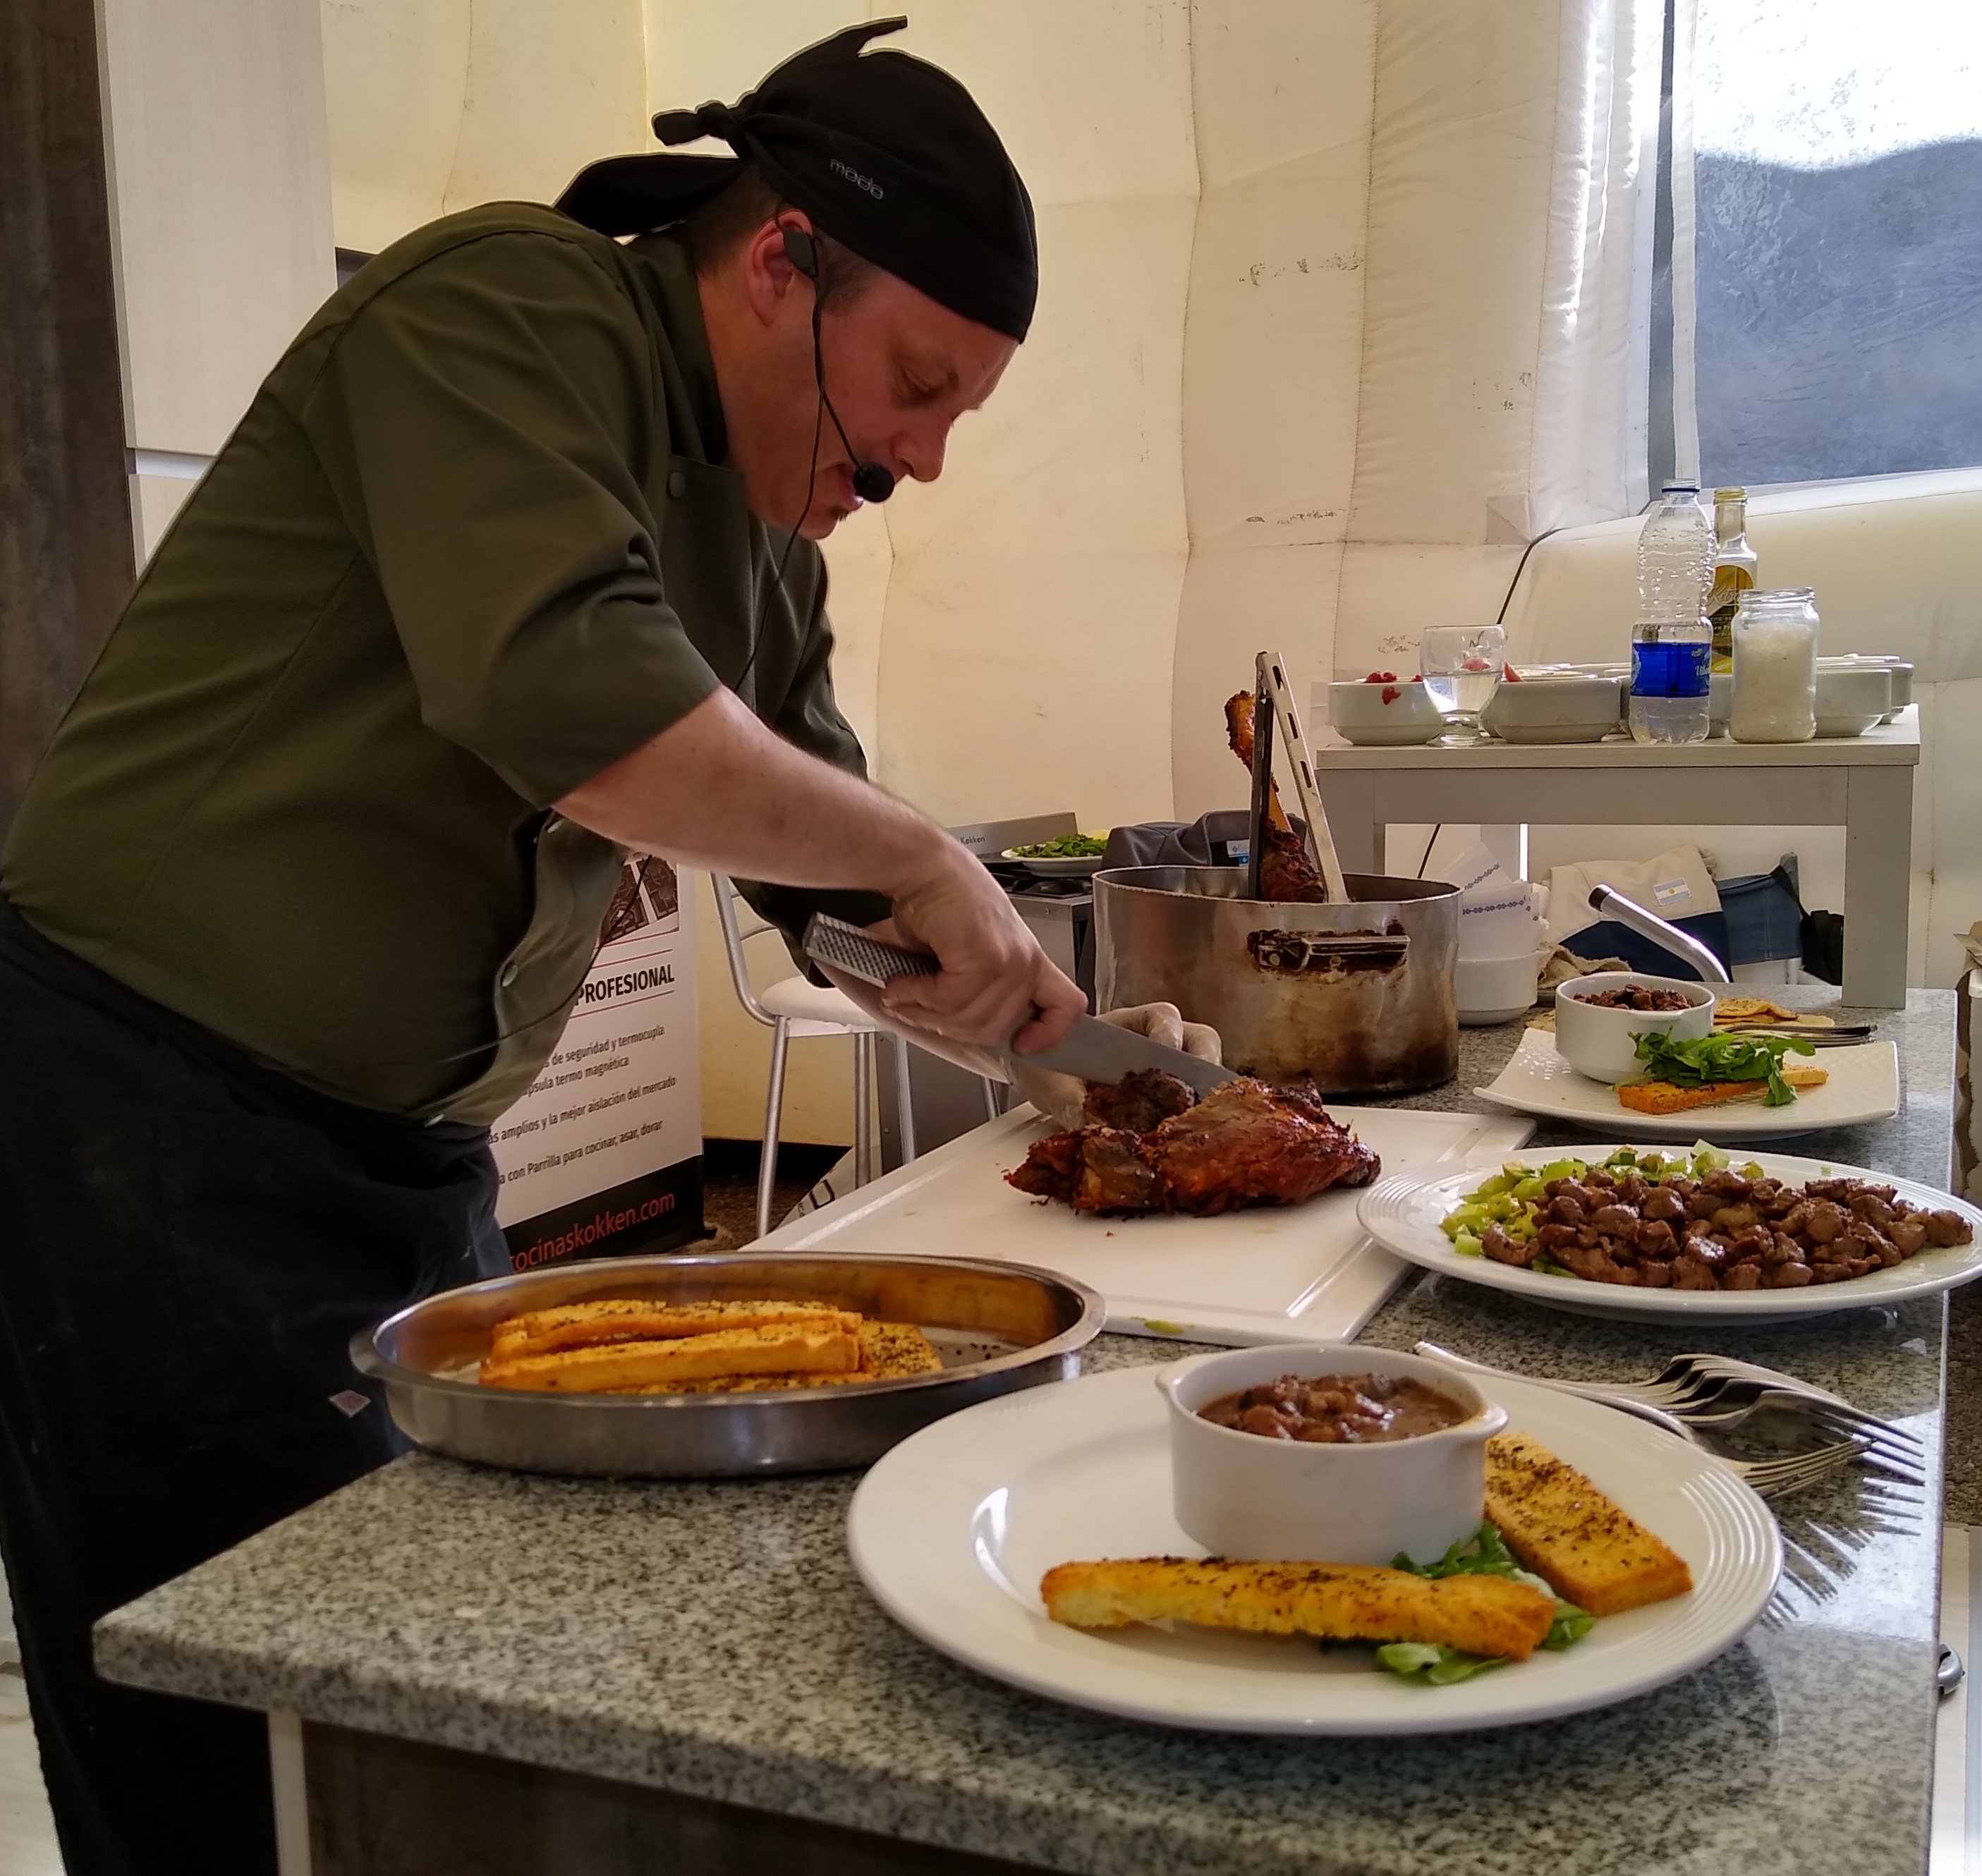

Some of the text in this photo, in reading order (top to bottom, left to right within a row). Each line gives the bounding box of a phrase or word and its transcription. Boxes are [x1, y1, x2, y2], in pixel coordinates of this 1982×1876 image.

[551, 1025, 665, 1066] de seguridad y termocupla
[525, 1056, 630, 1098] psula termo magnética
[501, 1119, 541, 1140] amplios
[541, 1117, 548, 1131] y
[549, 1113, 559, 1126] la
[560, 1104, 586, 1123] mejor
[588, 1091, 626, 1113] aislación
[627, 1085, 642, 1101] del
[642, 1076, 677, 1095] mercado
[507, 1167, 526, 1182] con
[527, 1154, 562, 1176] Parrilla
[563, 1147, 584, 1166] para
[640, 1120, 664, 1136] dorar
